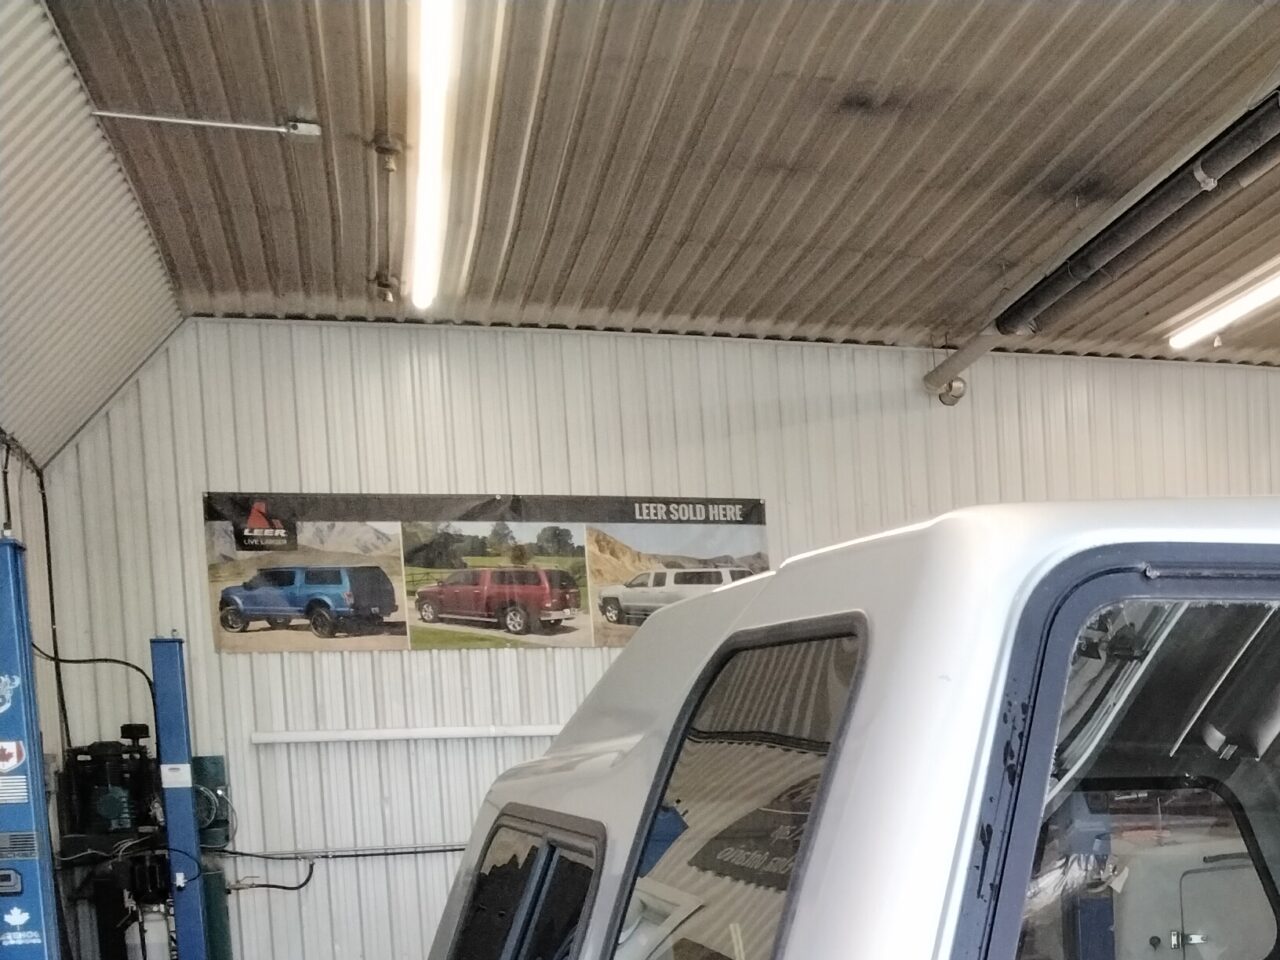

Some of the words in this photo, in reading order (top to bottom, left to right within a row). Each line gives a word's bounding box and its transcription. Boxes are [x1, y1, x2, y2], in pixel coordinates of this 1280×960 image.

[634, 503, 667, 520] LEER
[669, 503, 706, 521] SOLD
[708, 504, 743, 521] HERE
[243, 528, 288, 537] LEER
